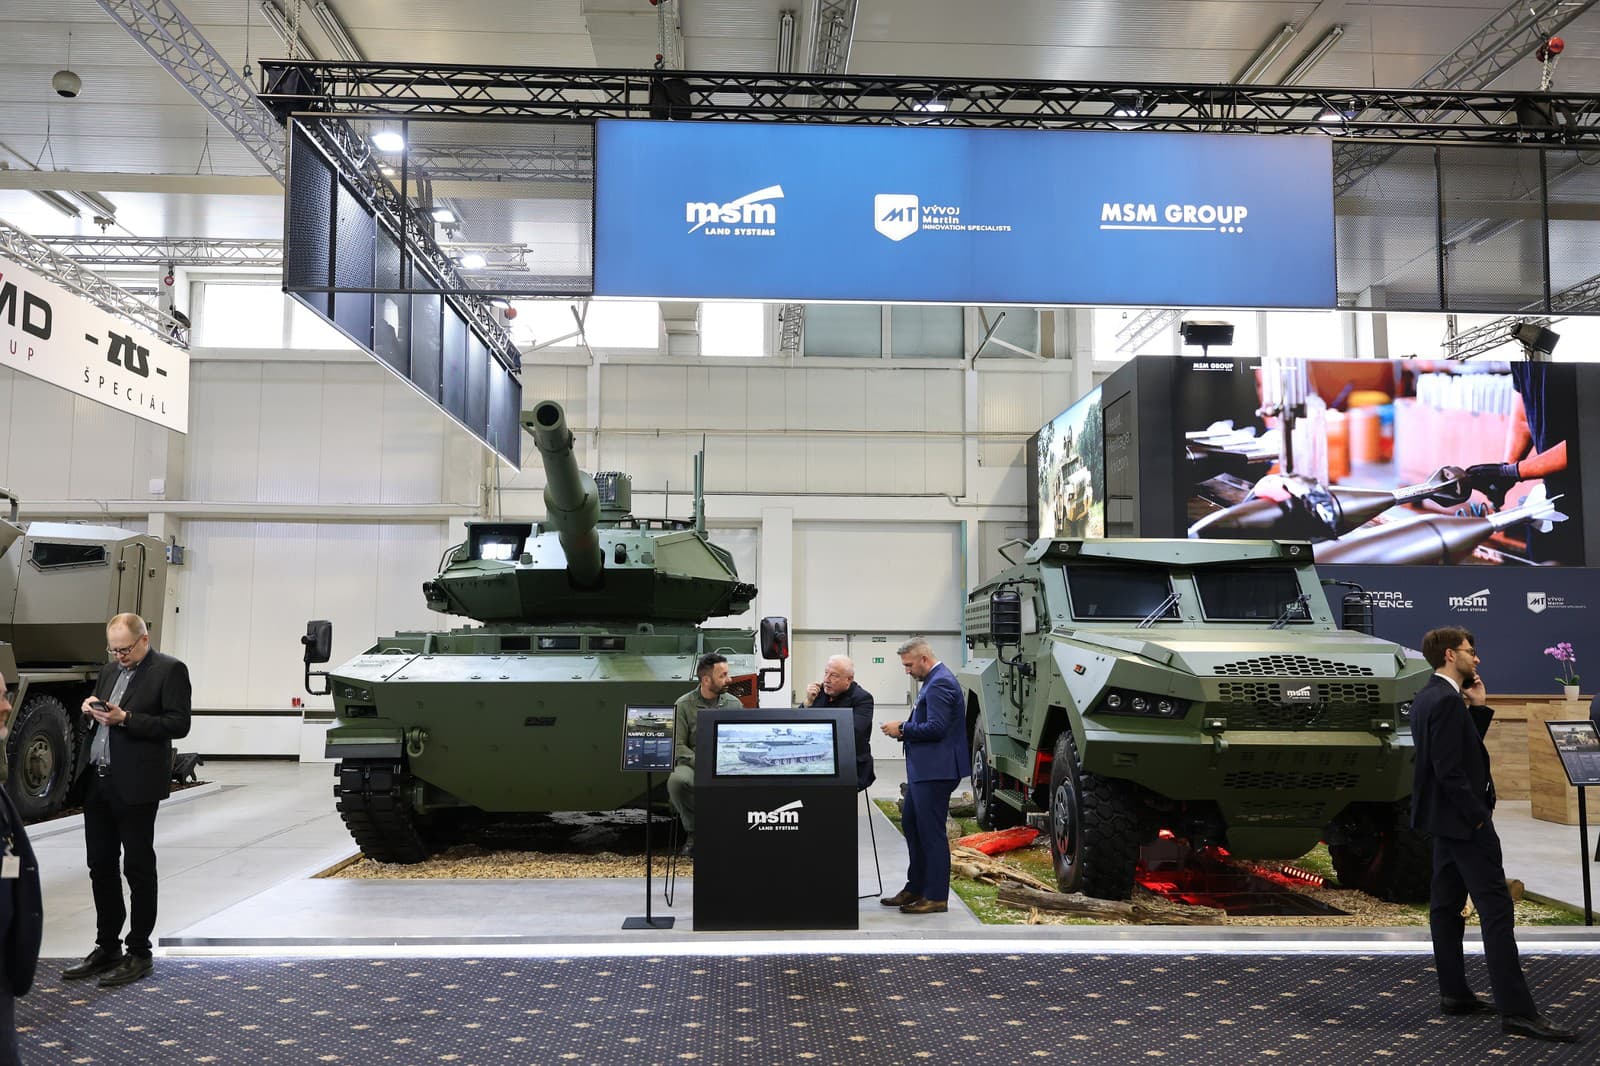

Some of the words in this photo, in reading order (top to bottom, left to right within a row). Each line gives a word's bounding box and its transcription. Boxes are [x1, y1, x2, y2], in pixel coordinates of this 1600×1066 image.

[922, 204, 960, 215] VÝVOJ
[1101, 203, 1157, 222] MSM
[1164, 204, 1248, 224] GROUP
[922, 215, 960, 224] Martin
[734, 228, 776, 236] SYSTEMS
[967, 224, 1012, 232] SPECIALISTS
[84, 366, 166, 415] ŠPECIÁL
